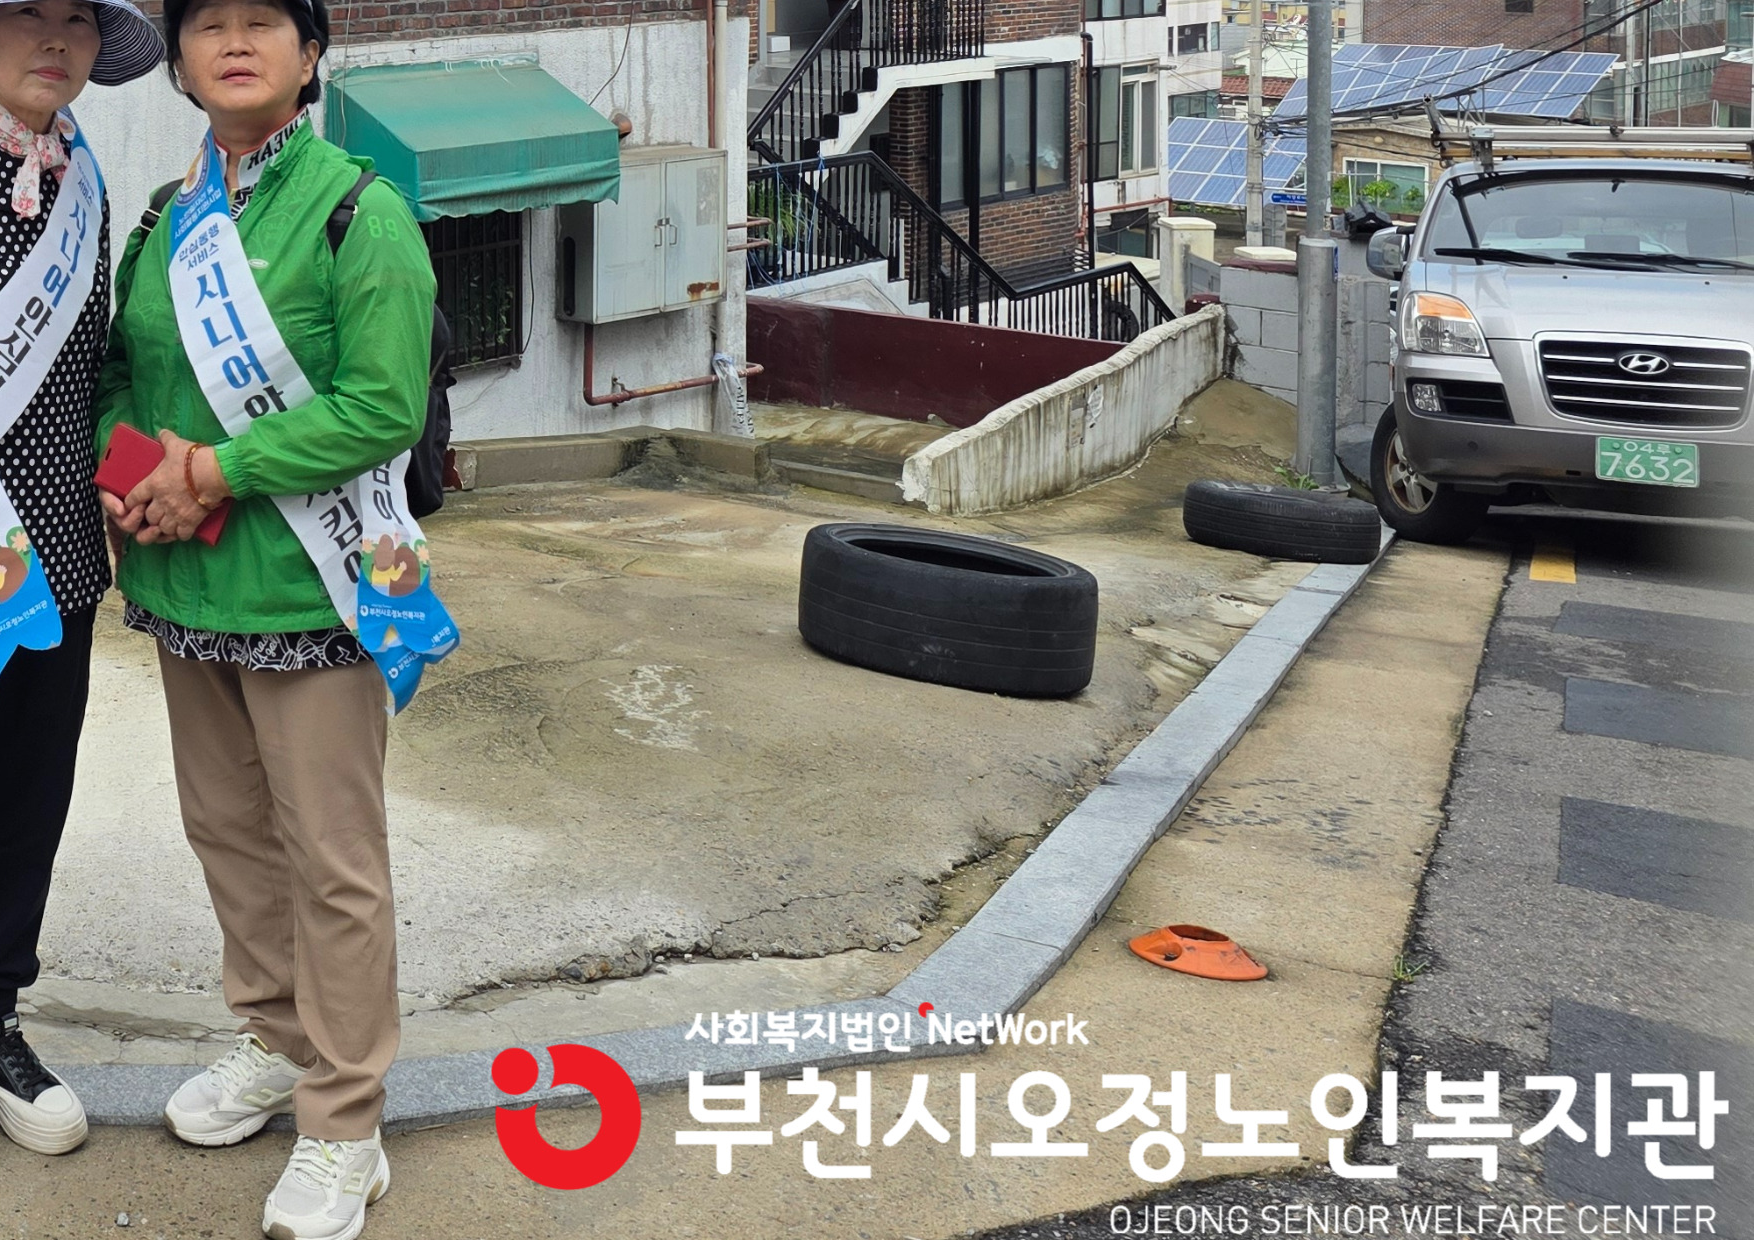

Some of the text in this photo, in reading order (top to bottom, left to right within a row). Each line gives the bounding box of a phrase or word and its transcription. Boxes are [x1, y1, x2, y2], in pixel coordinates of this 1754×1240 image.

[367, 215, 399, 242] 89
[42, 199, 87, 309] 시니어
[186, 242, 220, 271] 서비스
[195, 261, 271, 390] 시니어
[1600, 451, 1695, 484] 7632
